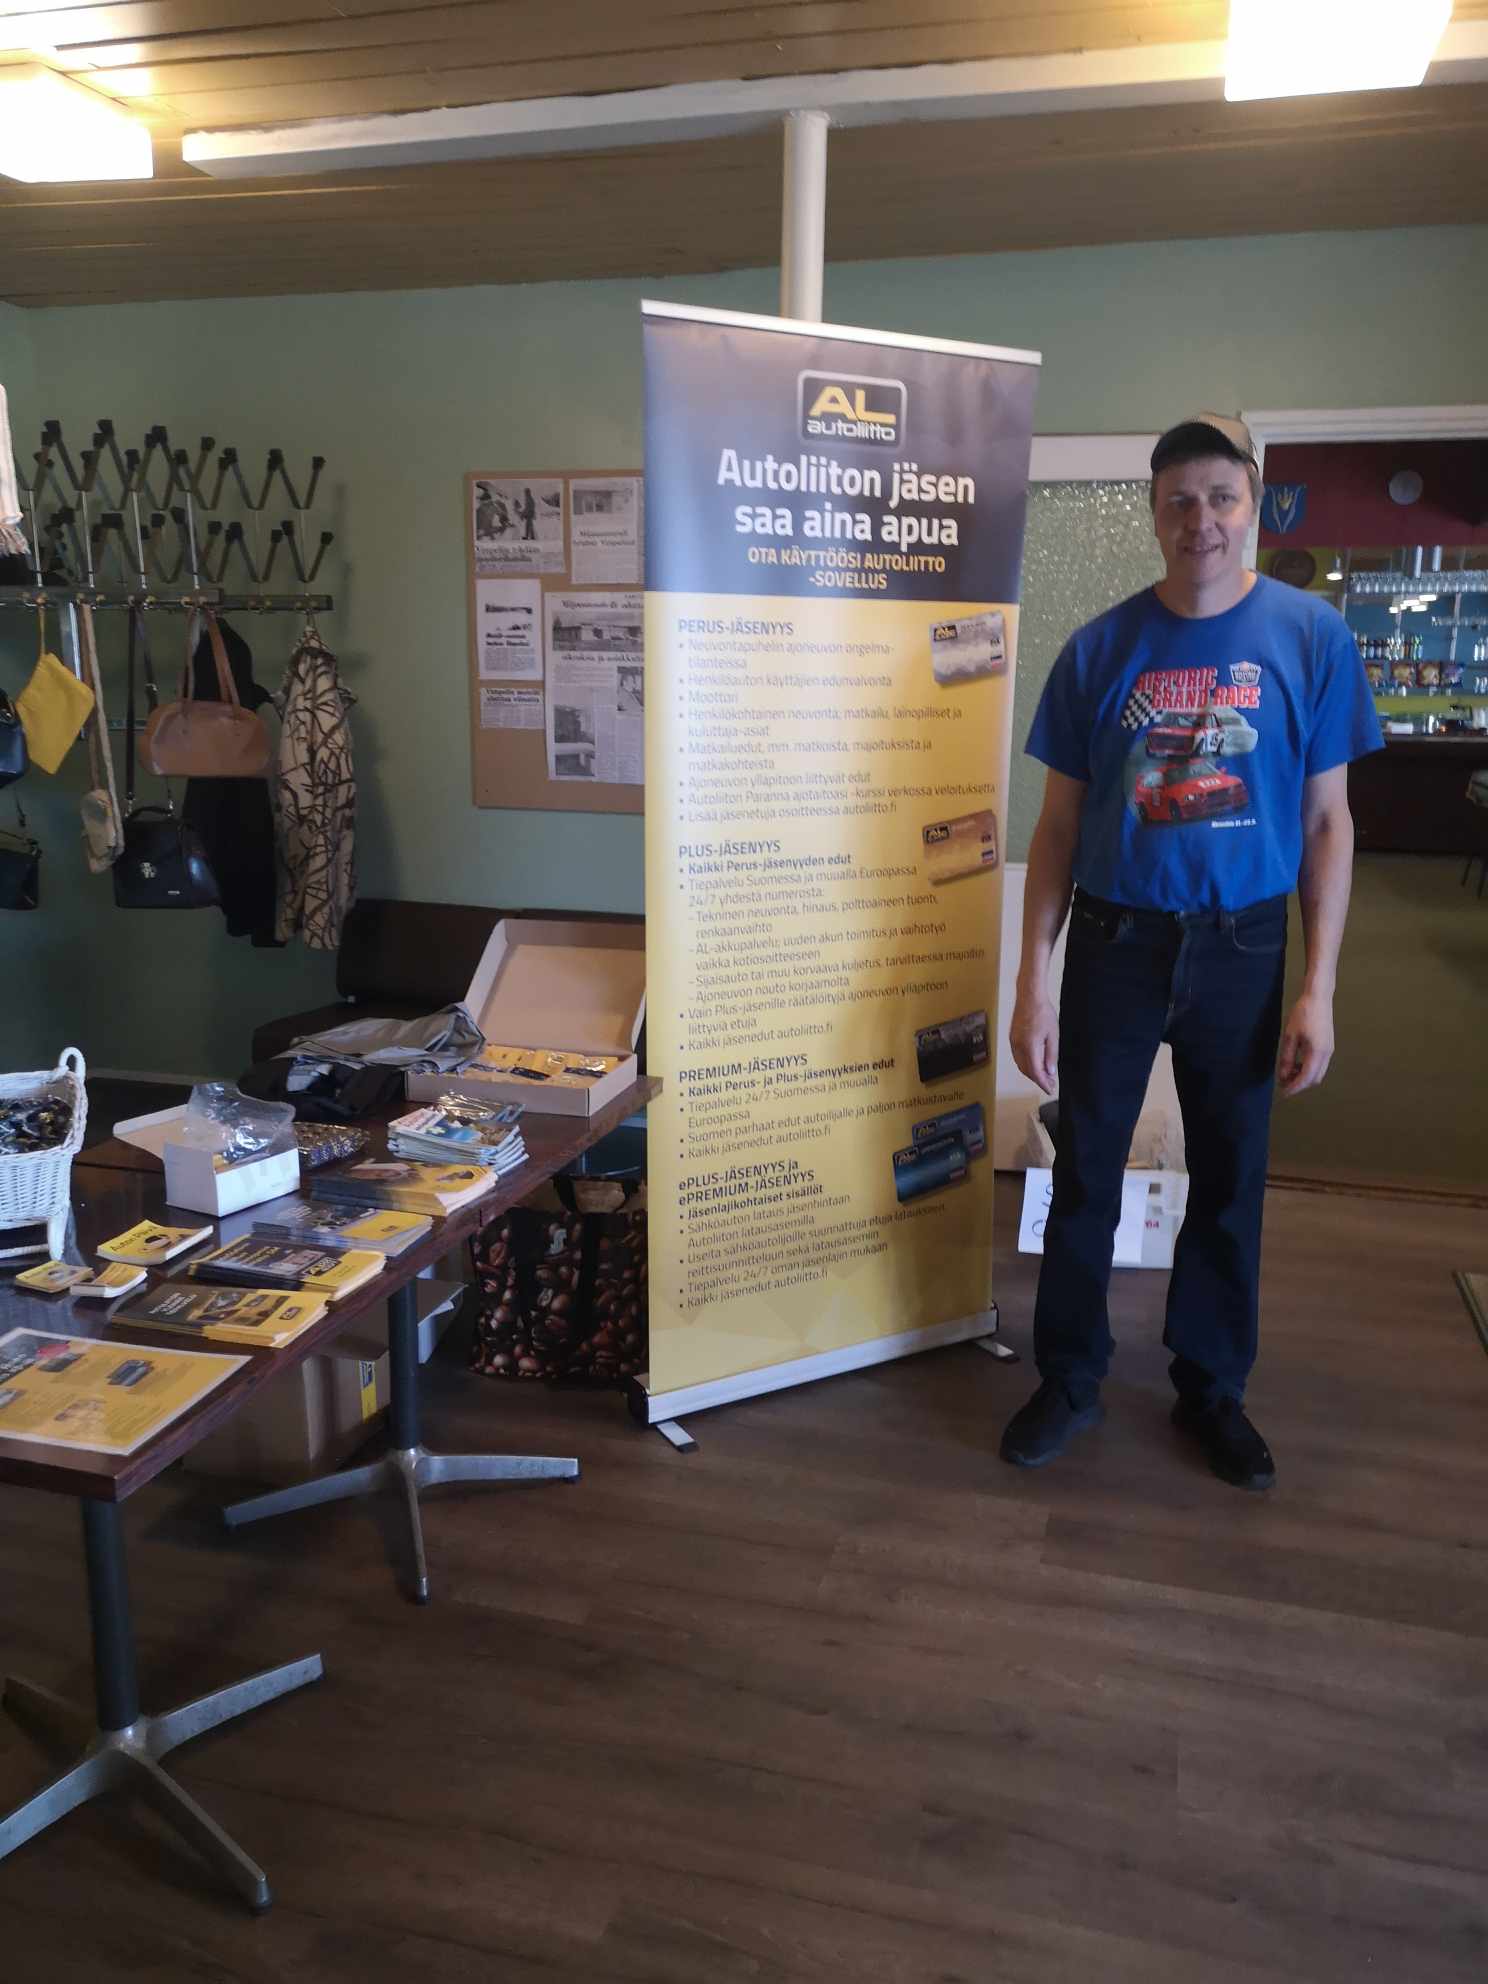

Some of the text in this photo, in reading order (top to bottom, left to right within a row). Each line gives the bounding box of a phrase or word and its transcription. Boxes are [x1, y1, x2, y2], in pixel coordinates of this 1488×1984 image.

[808, 385, 897, 426] AL
[806, 419, 896, 441] autoliitto
[717, 448, 976, 509] Autoliiton jäsen
[735, 502, 959, 552] saa aina apua
[748, 547, 945, 573] OTA KÄYTTÖÖSI AUTOLIITTO
[809, 572, 888, 590] -SOVELLUS
[678, 617, 794, 636] PERUS-JÄSENYYS
[1135, 667, 1218, 692] HISTORIC
[1151, 685, 1261, 711] GRAND RACE
[953, 707, 963, 721] ja
[923, 740, 933, 752] ja
[848, 771, 871, 783] edut
[679, 839, 782, 858] PLUS-JÄSENYYS
[688, 853, 852, 874] Kaikki Perus-jäsenyyden edut
[688, 865, 917, 891] Tiepalvelu Suomessa ja muualla Euroopassa
[688, 894, 716, 907] 24/7
[720, 889, 761, 907] yhdestä
[696, 909, 745, 922] Tekninen
[841, 897, 905, 914] polttoaineen
[696, 922, 773, 939] renkaanvaihto
[783, 932, 816, 946] uuden
[820, 930, 844, 943] akun
[846, 927, 889, 940] toimitus
[889, 927, 898, 939] ja
[696, 957, 730, 970] vaikka
[751, 968, 765, 980] tai
[767, 968, 790, 978] muu
[792, 964, 839, 977] korvaava
[696, 976, 850, 1003] Ajoneuvon nouto korjaamolta
[688, 1005, 713, 1019] Vain
[715, 998, 786, 1016] Plus-jäsenille
[730, 1017, 758, 1030] etuja
[688, 1022, 834, 1051] Kaikki jäsenedut autoliitto.fi
[679, 1053, 808, 1082] PREMIUM-JÄSENYYS
[688, 1057, 896, 1097] Kaikki Perus- ja Plus-jäsenyyksien edut
[688, 1075, 880, 1113] Tiepalvelu 24/7 Suomessa ja muualla
[688, 1110, 752, 1130] Euroopassa
[688, 1128, 733, 1144] Suomen
[735, 1120, 776, 1138] parhaat
[777, 1116, 801, 1129] edut
[855, 1105, 865, 1119] ja
[867, 1102, 896, 1117] paljon
[688, 1125, 832, 1159] Kaikki jäsenedut autoliitto.fi
[678, 1158, 800, 1191] ePLUS-JÄSENYYS ja
[678, 1170, 815, 1206] ePREMIUM-JÄSENYYS
[688, 1183, 824, 1220] Jäsenlajikohtaiset sisällöt
[688, 1213, 751, 1235] Sähköauton
[752, 1207, 785, 1222] lataus
[688, 1213, 816, 1250] Autoliiton latausasemilla
[688, 1248, 721, 1265] Useita
[785, 1243, 811, 1258] sekä
[688, 1271, 740, 1293] Tiepalvelu
[742, 1265, 768, 1282] 24/7
[770, 1260, 800, 1275] oman
[849, 1241, 888, 1258] mukaan
[687, 1293, 719, 1309] Kaikki
[773, 1269, 829, 1289] autoliitto.fi
